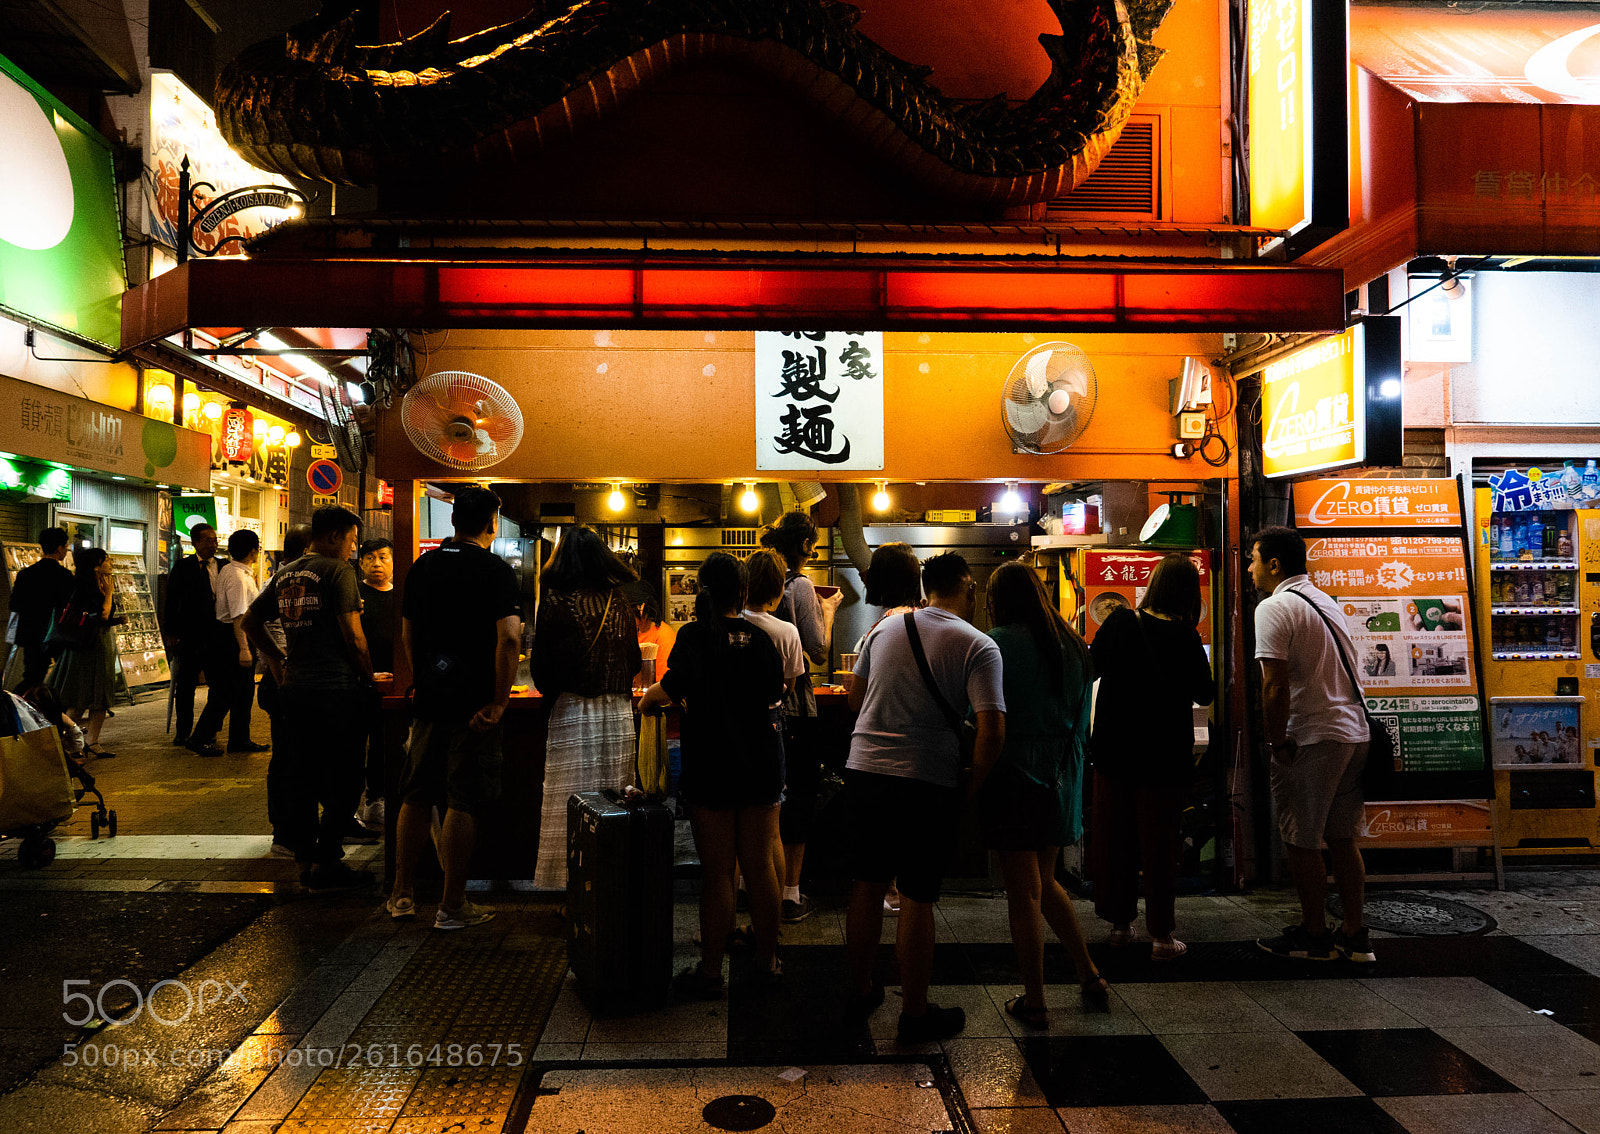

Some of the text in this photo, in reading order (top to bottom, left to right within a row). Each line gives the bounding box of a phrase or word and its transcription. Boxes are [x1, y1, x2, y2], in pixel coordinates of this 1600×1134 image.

[1326, 496, 1410, 515] ZERO賃貸
[1402, 537, 1461, 545] 0120-799-995
[1379, 699, 1399, 711] 24
